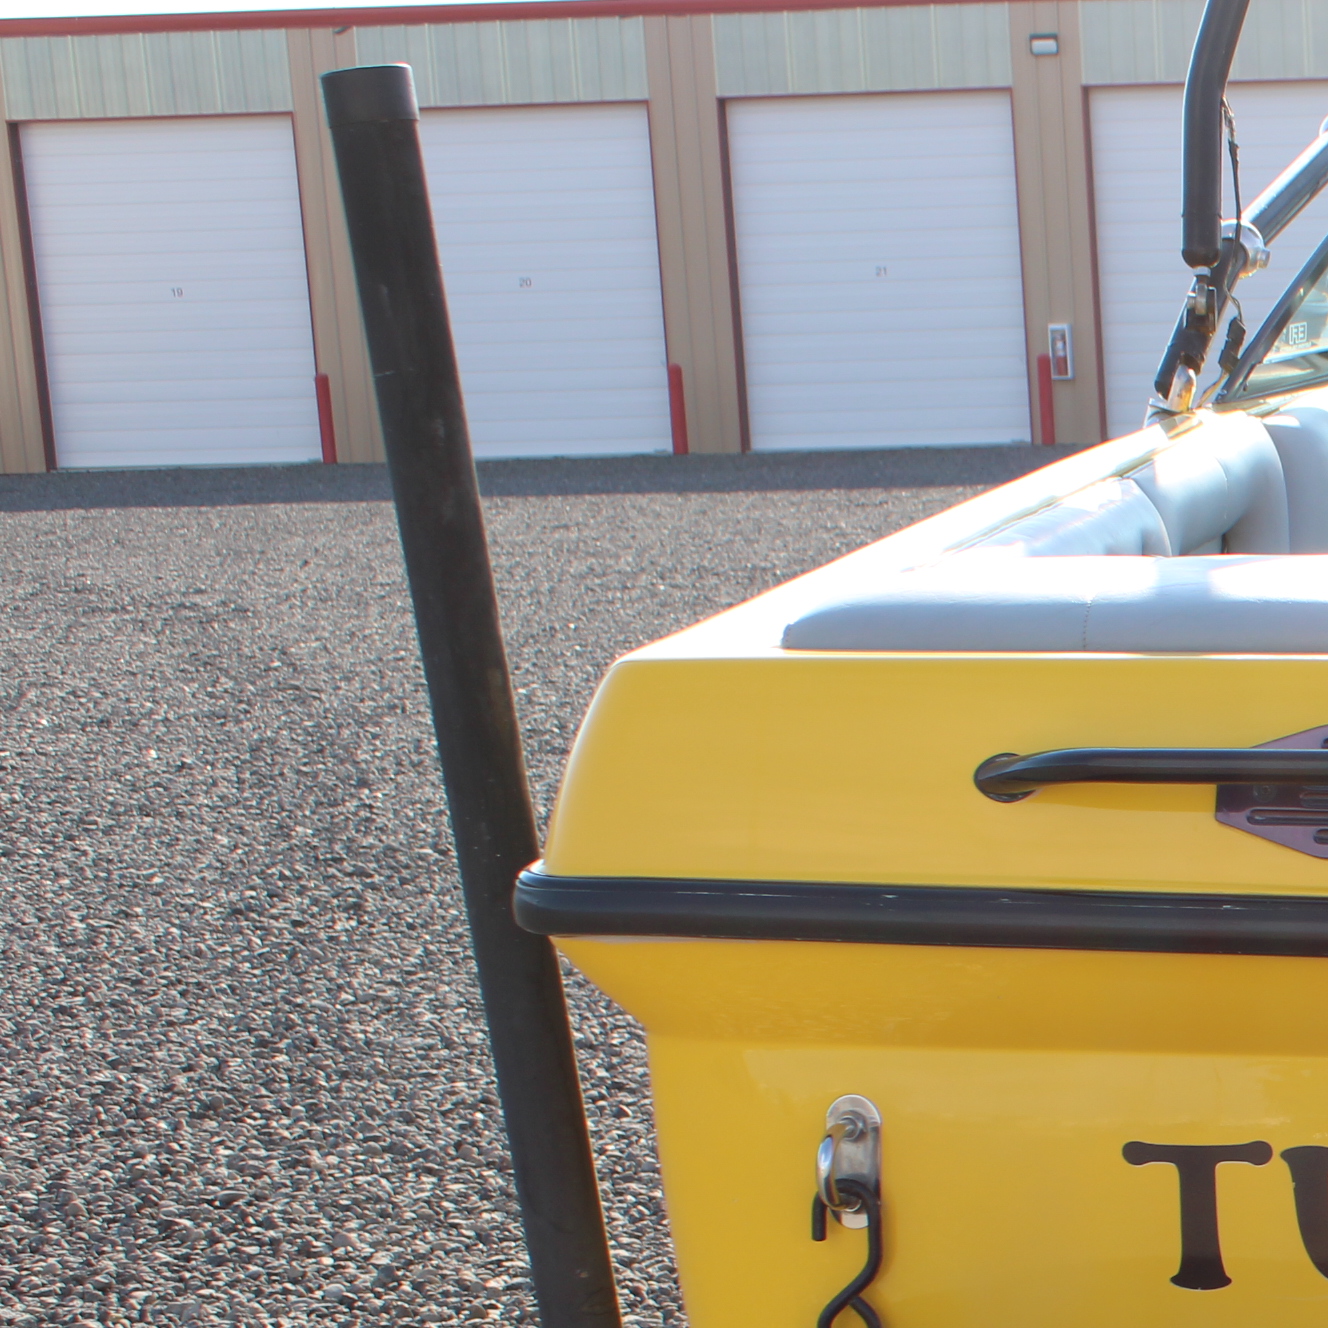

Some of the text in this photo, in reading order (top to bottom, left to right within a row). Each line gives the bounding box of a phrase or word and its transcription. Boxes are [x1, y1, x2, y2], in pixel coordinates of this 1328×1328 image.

[875, 265, 888, 277] 21
[518, 277, 532, 288] 20
[171, 287, 184, 298] 19
